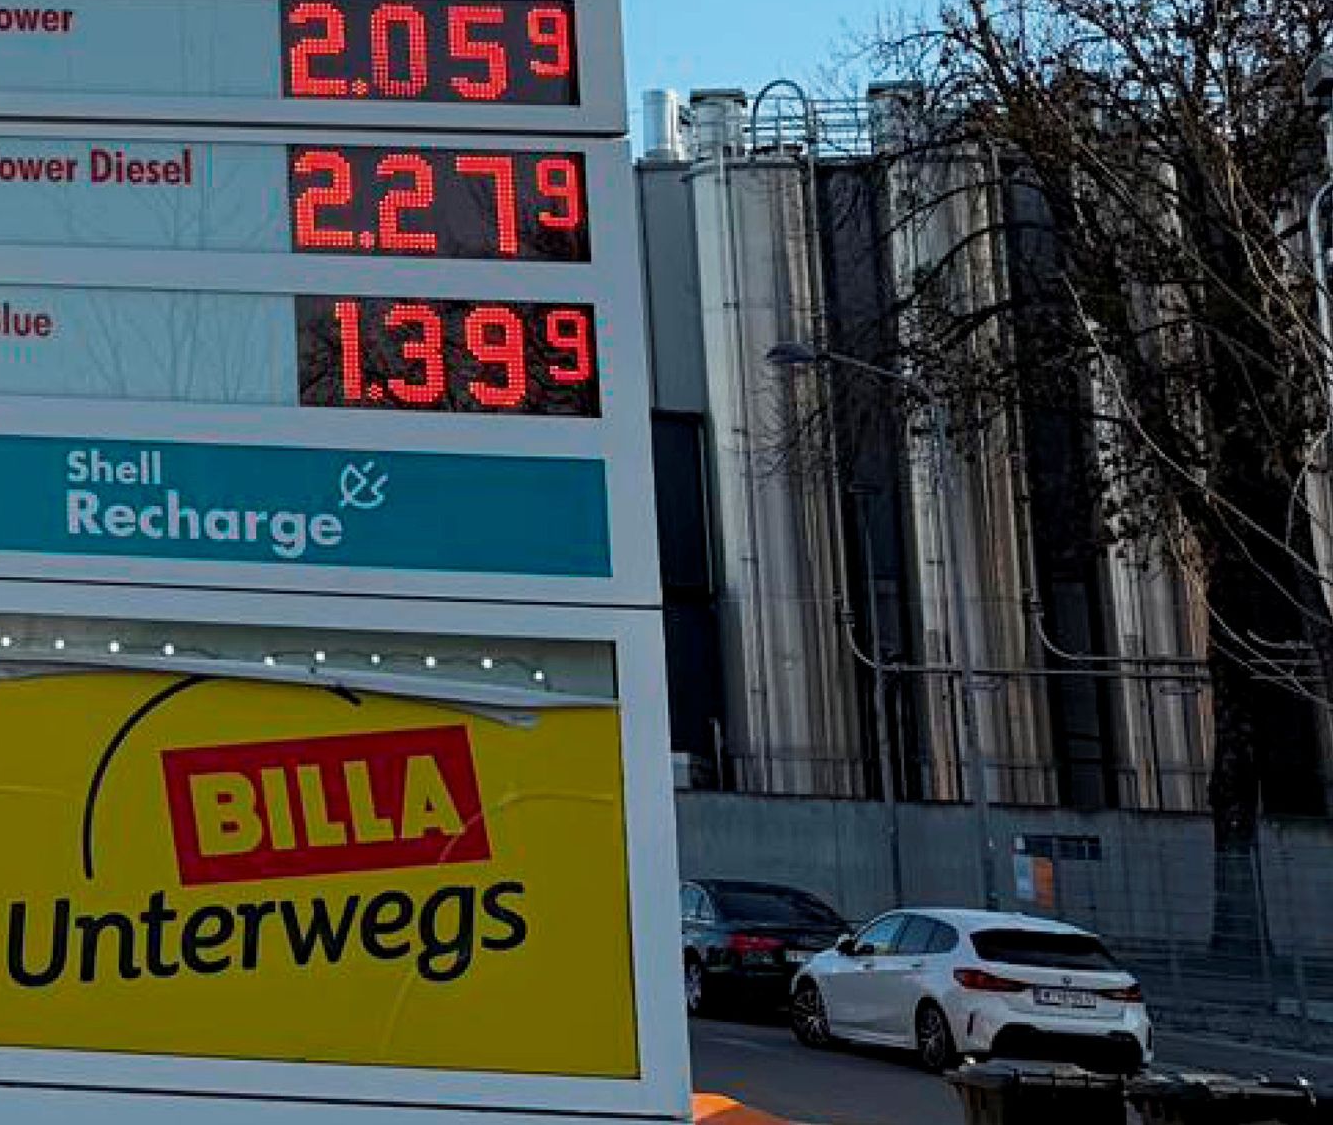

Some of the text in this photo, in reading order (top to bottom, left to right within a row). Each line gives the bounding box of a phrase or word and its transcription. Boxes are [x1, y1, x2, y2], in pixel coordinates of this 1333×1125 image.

[287, 2, 570, 100] 2.059
[89, 149, 193, 186] Diesel
[293, 150, 583, 254] 2.279
[333, 301, 591, 406] 1.399
[65, 450, 162, 485] Shell
[65, 490, 344, 558] Recharge
[188, 754, 465, 857] BILLA
[7, 881, 527, 987] Unterwegs
